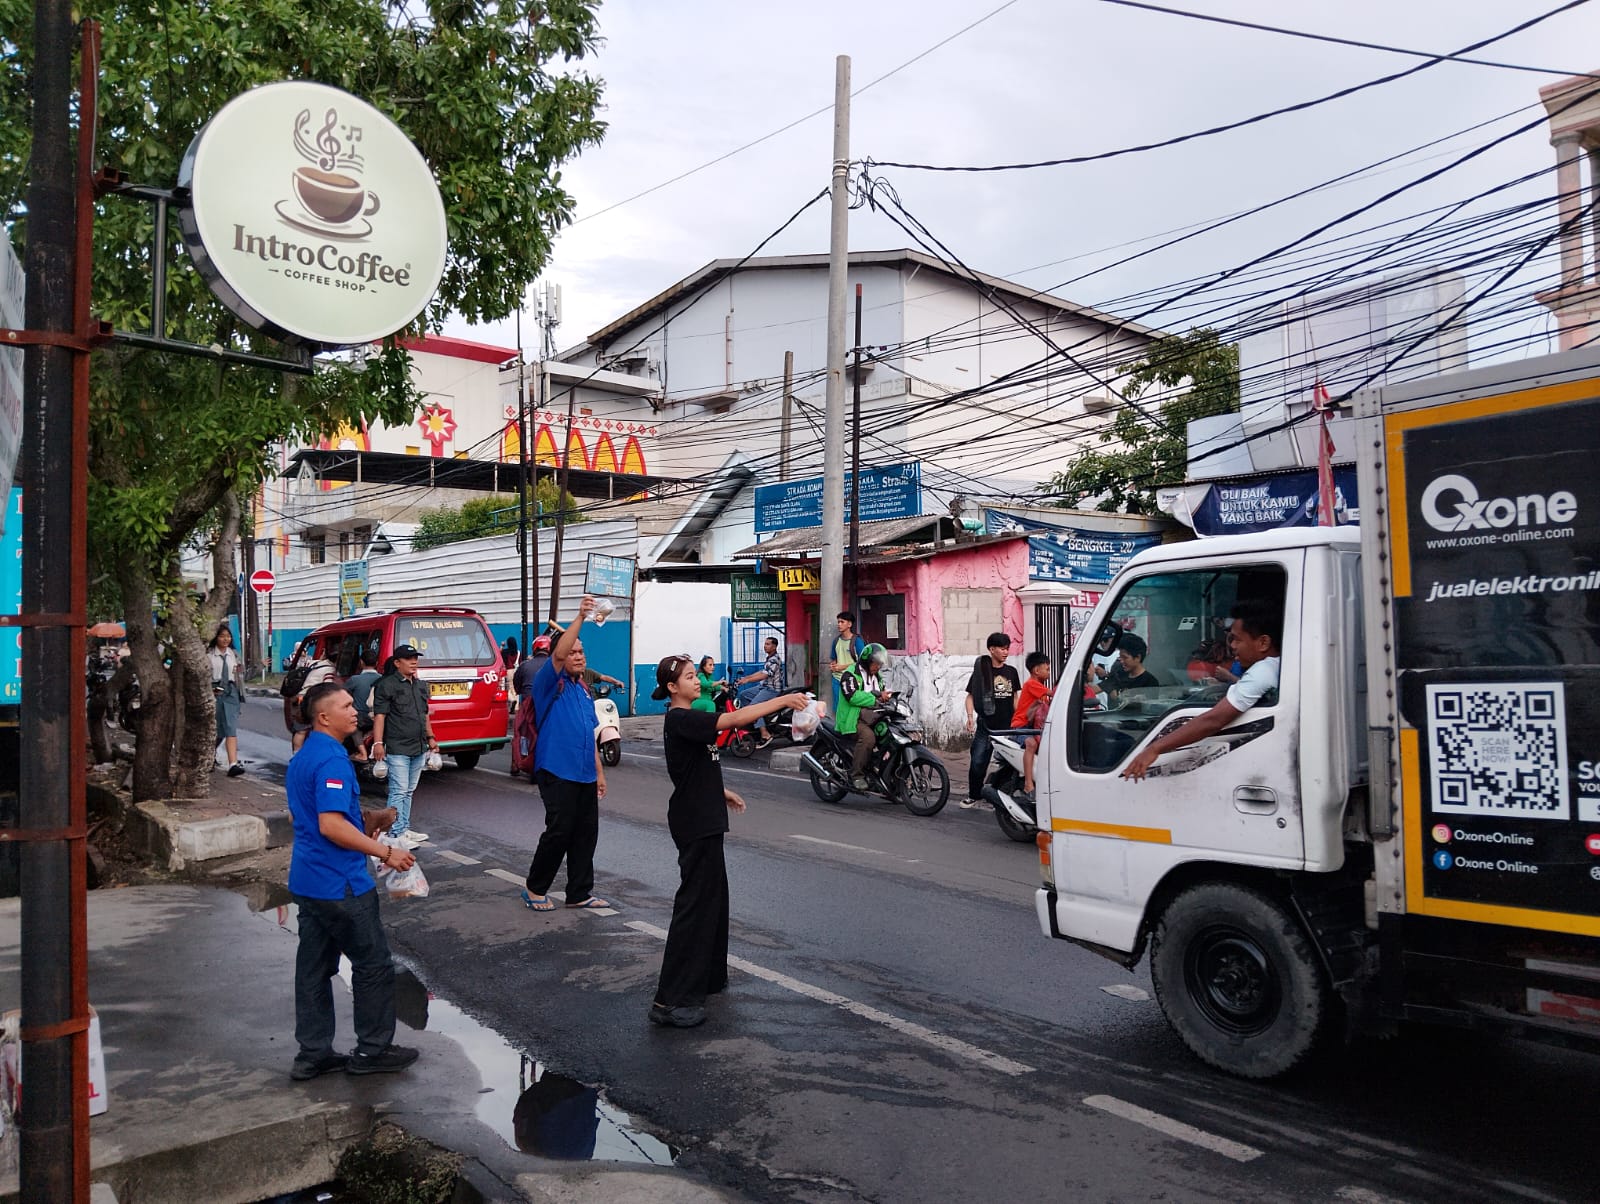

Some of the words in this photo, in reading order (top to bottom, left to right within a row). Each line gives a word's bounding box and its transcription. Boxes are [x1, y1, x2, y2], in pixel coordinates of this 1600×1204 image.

[284, 268, 331, 287] COFFEE
[335, 278, 366, 294] SHOP
[1220, 489, 1241, 500] OLI
[1241, 486, 1269, 499] BAIK
[1220, 499, 1261, 512] UNTUK
[1261, 495, 1299, 510] KAMU
[1421, 474, 1578, 532] Oxone
[1220, 511, 1256, 525] YANG
[1256, 508, 1286, 523] BAIK
[1426, 527, 1575, 550] www.oxone-online.com
[483, 670, 498, 685] 06
[1480, 738, 1510, 747] SCAN
[1481, 746, 1510, 756] HERE
[1454, 829, 1535, 846] OxoneOnline
[1454, 856, 1495, 870] Oxone
[1496, 859, 1539, 874] Online
